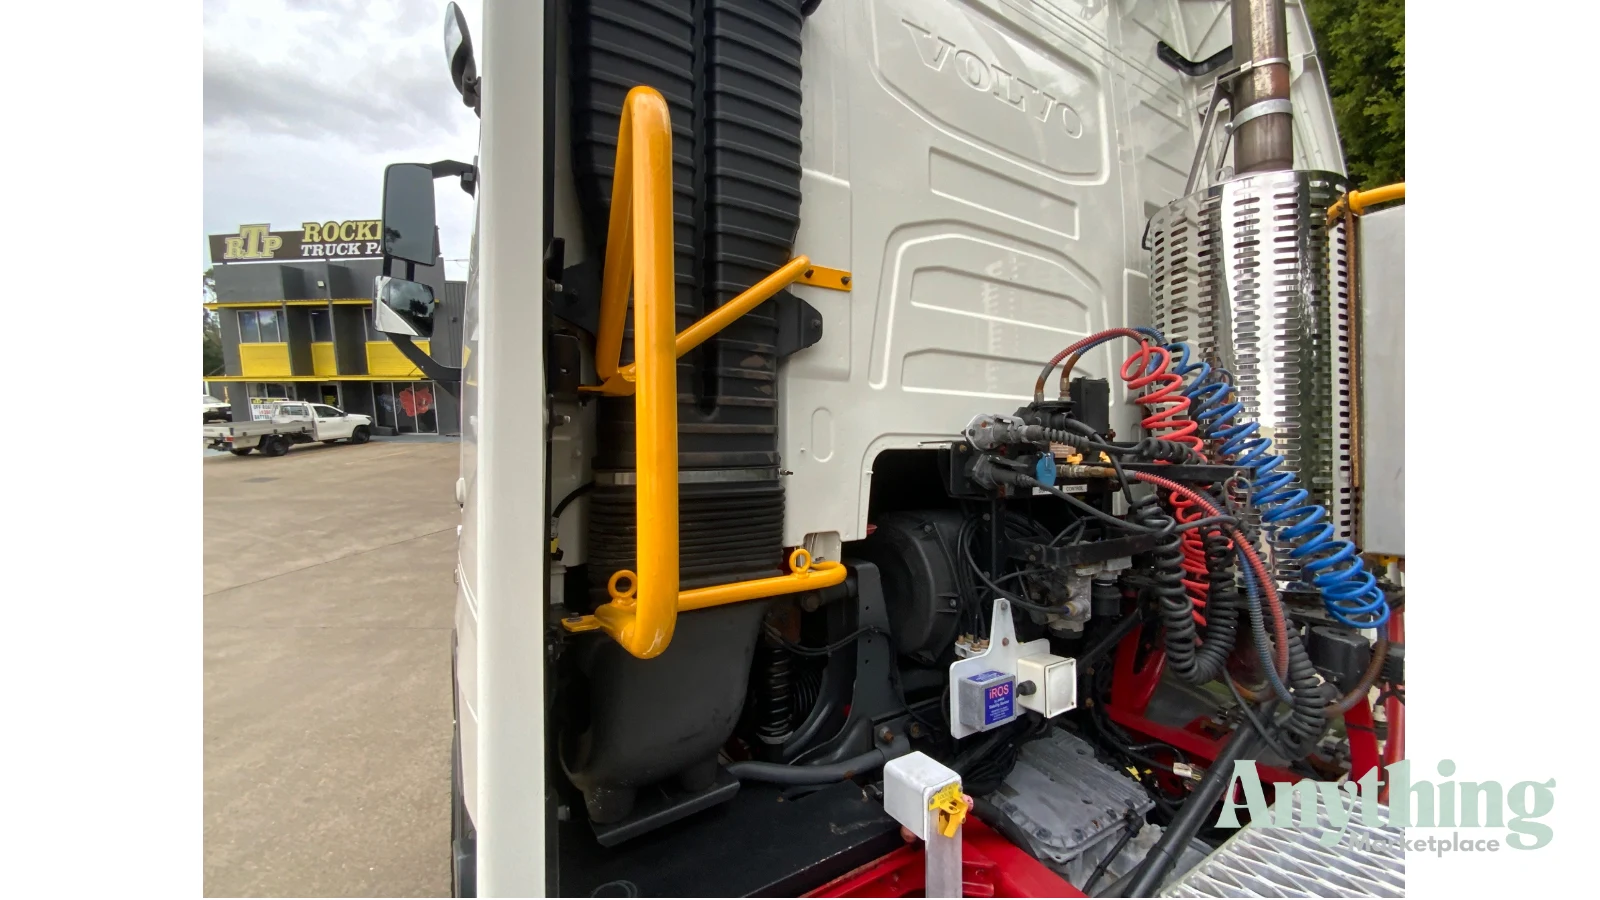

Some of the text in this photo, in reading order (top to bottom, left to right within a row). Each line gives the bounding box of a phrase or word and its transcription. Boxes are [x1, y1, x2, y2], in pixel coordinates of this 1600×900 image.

[901, 18, 1083, 139] VOLVO
[223, 223, 283, 259] RTP
[301, 243, 361, 256] TRUCK
[989, 684, 1009, 699] iROS
